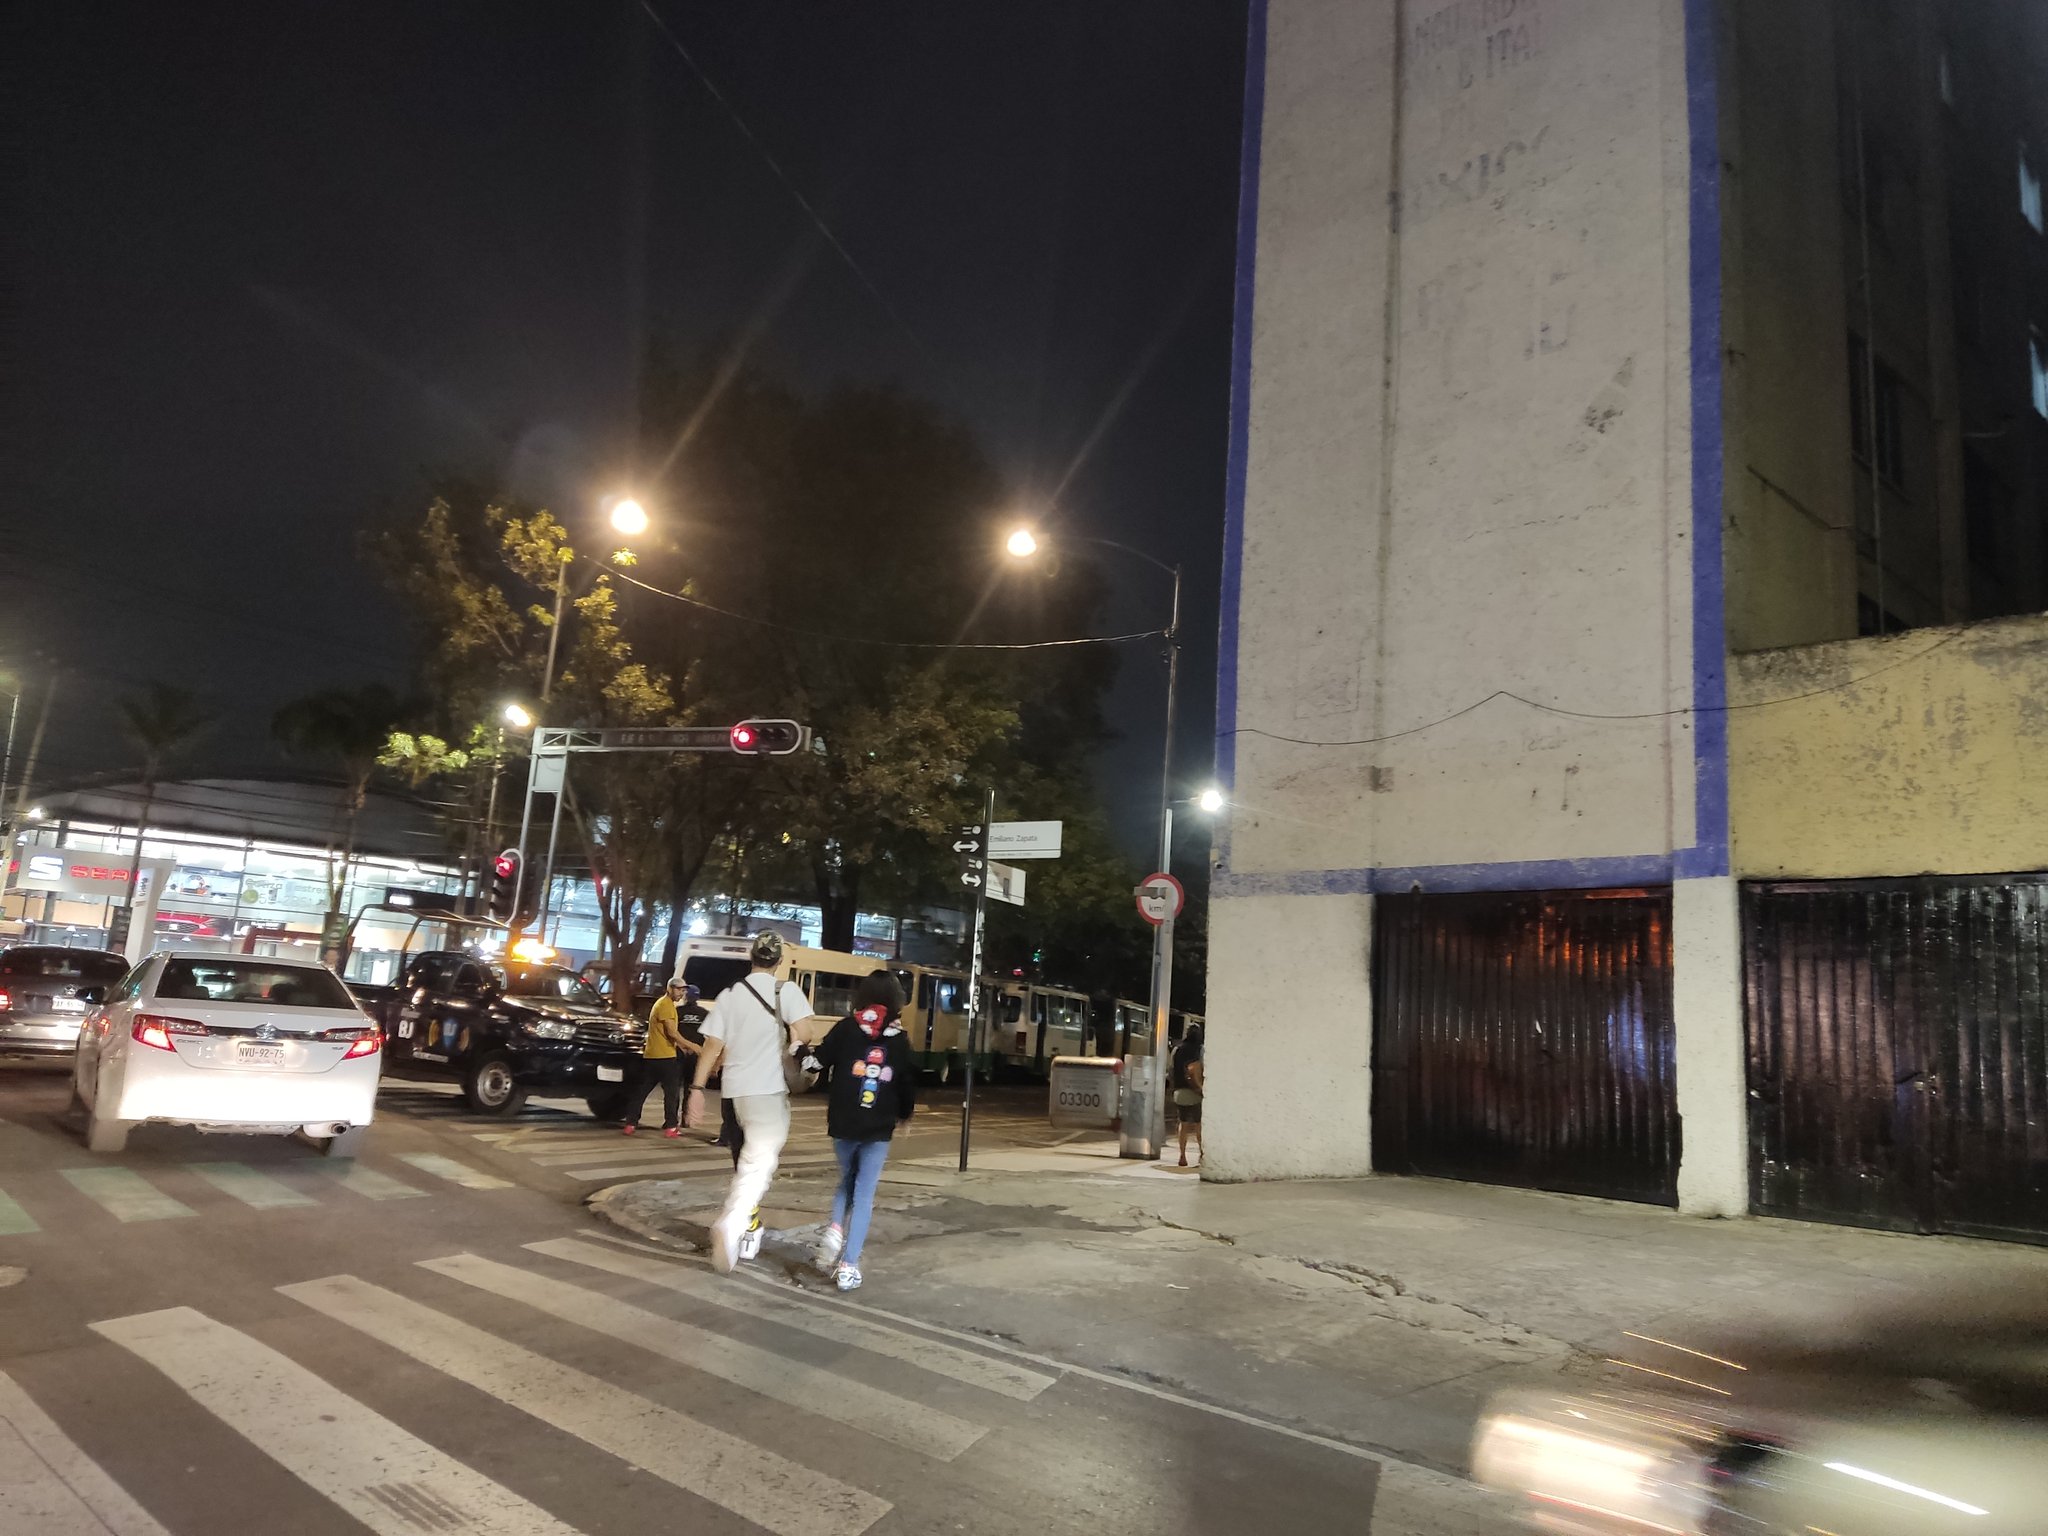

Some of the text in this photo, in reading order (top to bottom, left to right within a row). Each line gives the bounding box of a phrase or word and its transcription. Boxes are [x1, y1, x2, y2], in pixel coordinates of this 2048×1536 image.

[989, 834, 1038, 845] Emiliano Zapata
[69, 864, 139, 882] SEA
[398, 1019, 415, 1039] BJ
[239, 1047, 284, 1058] NVU-92-75
[1059, 1091, 1100, 1107] 03300
